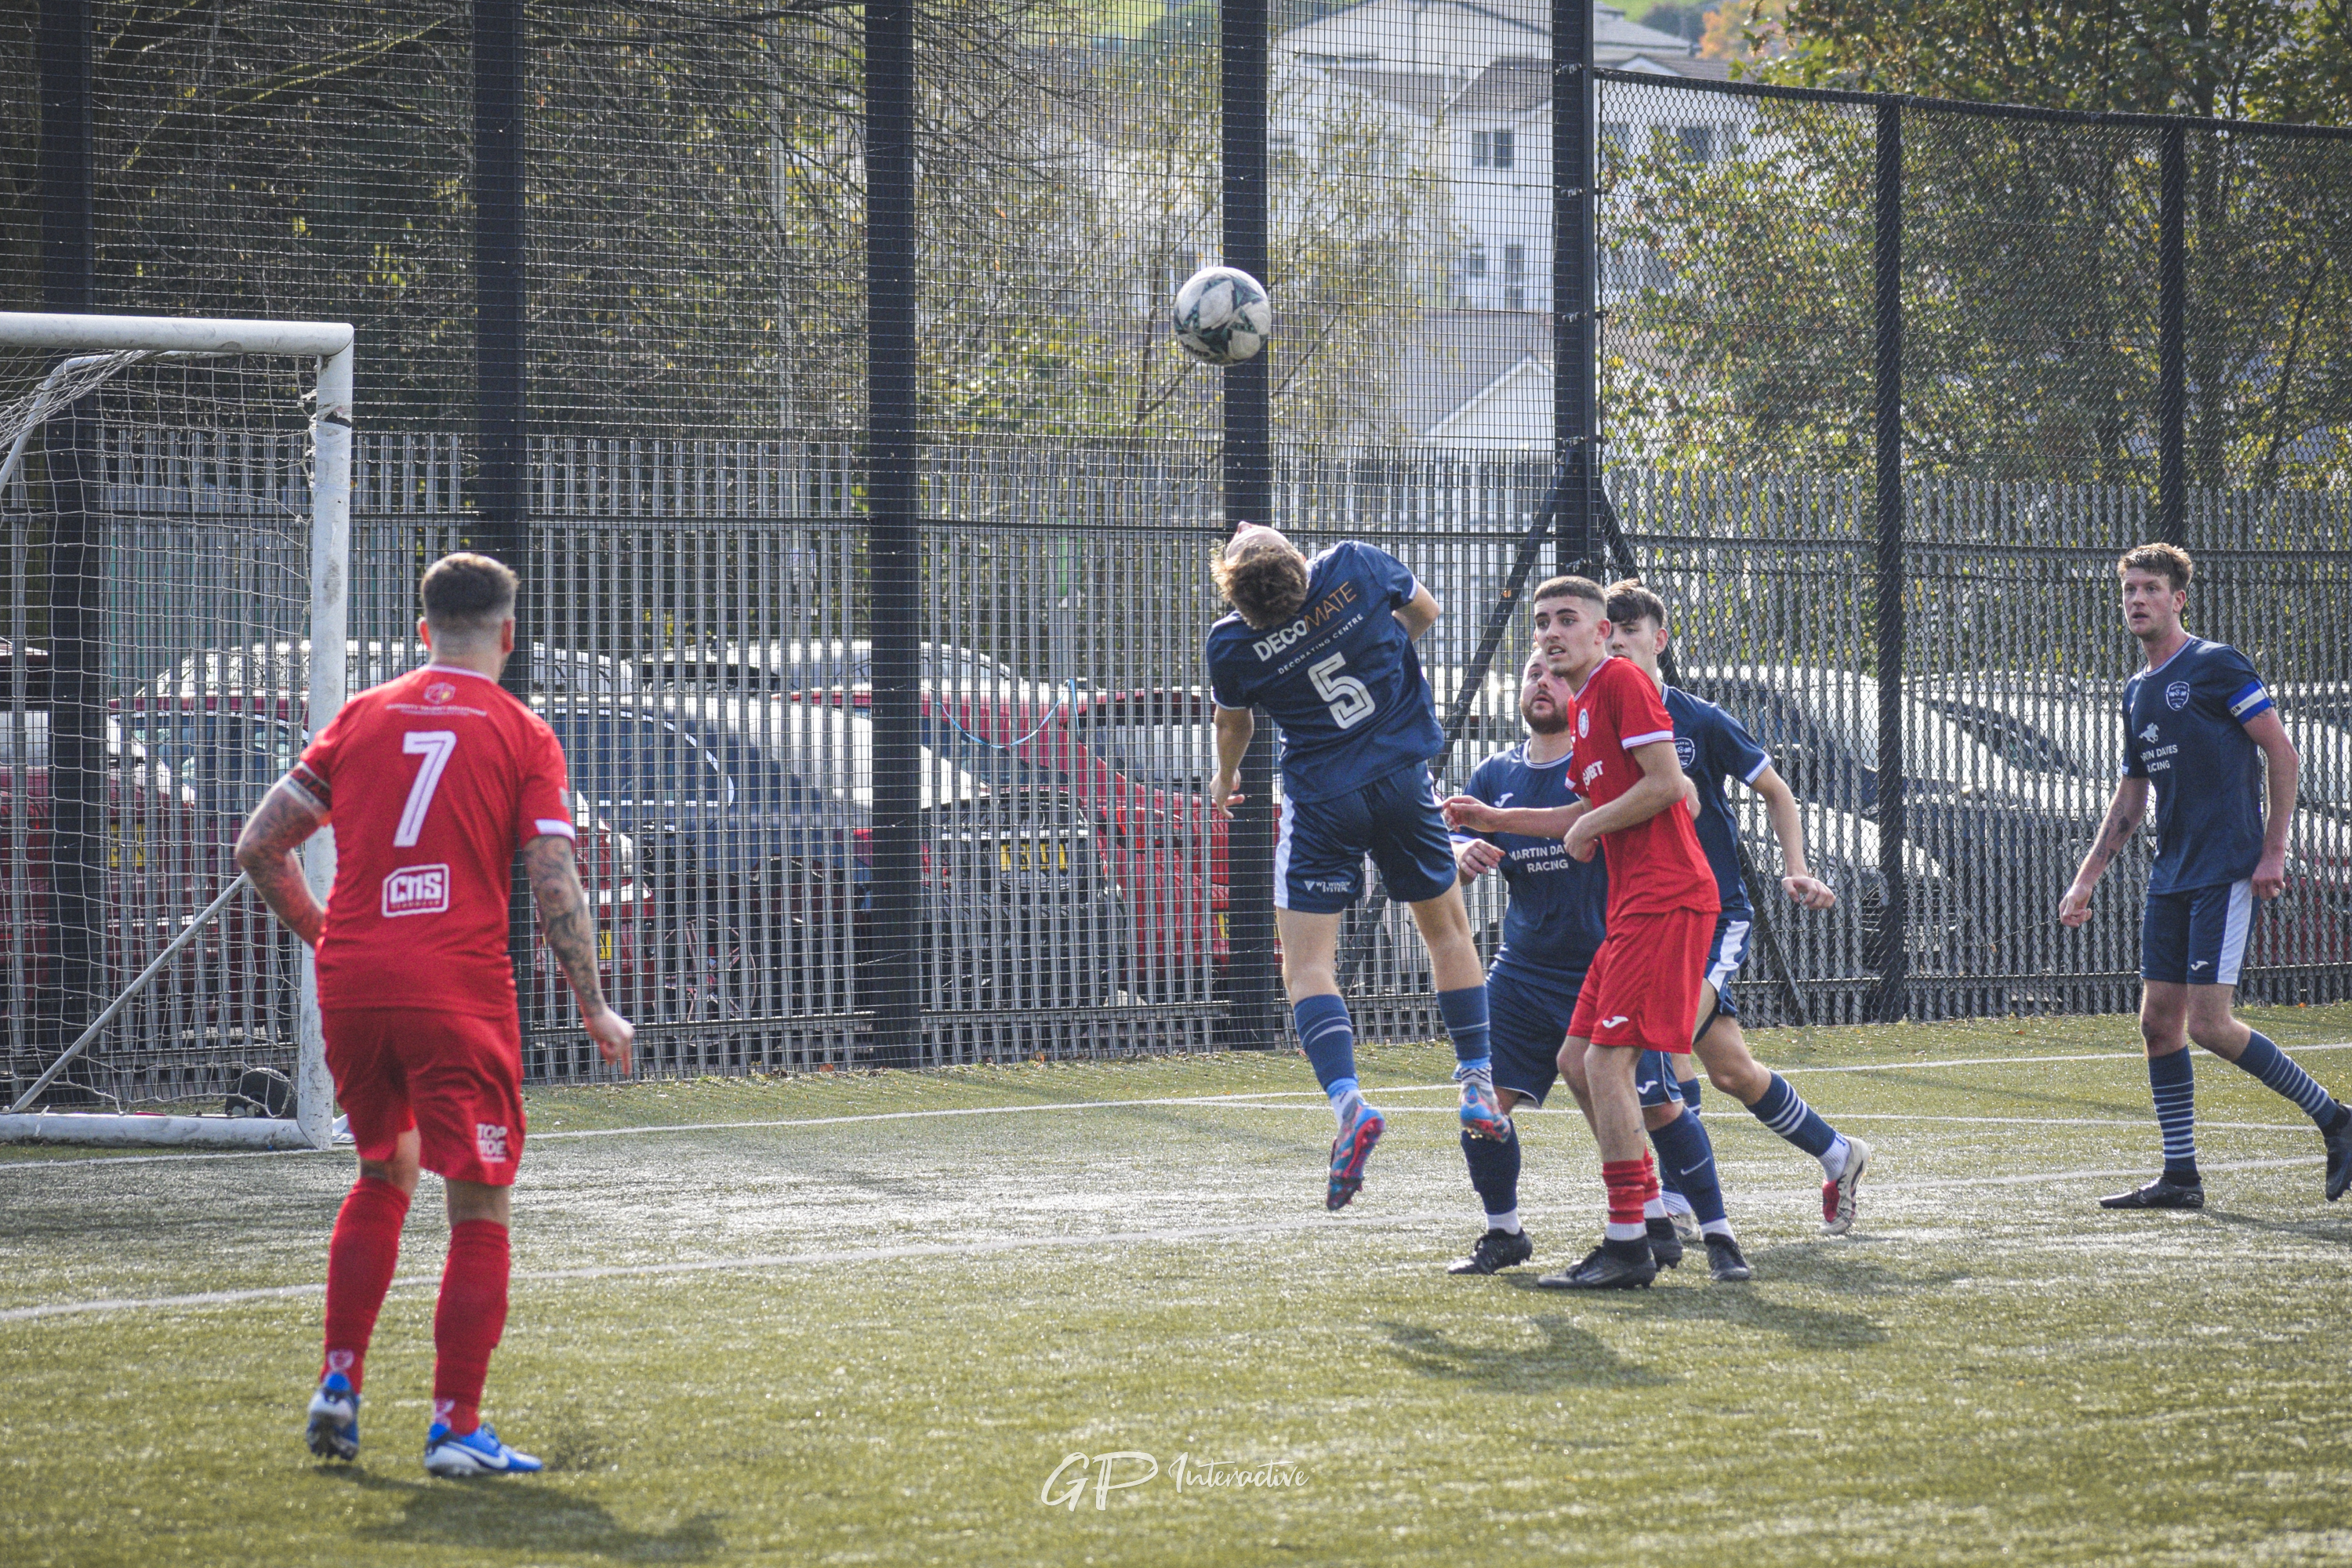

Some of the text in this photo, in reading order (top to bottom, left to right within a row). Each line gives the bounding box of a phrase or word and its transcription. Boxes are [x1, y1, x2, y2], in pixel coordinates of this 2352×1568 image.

[1278, 614, 1363, 674] DECORATING CENTRE
[1308, 652, 1376, 730] 5
[394, 730, 457, 848] 7
[1508, 847, 1548, 862] MARTIN
[1526, 858, 1568, 873] RACING
[390, 871, 442, 904] CMS
